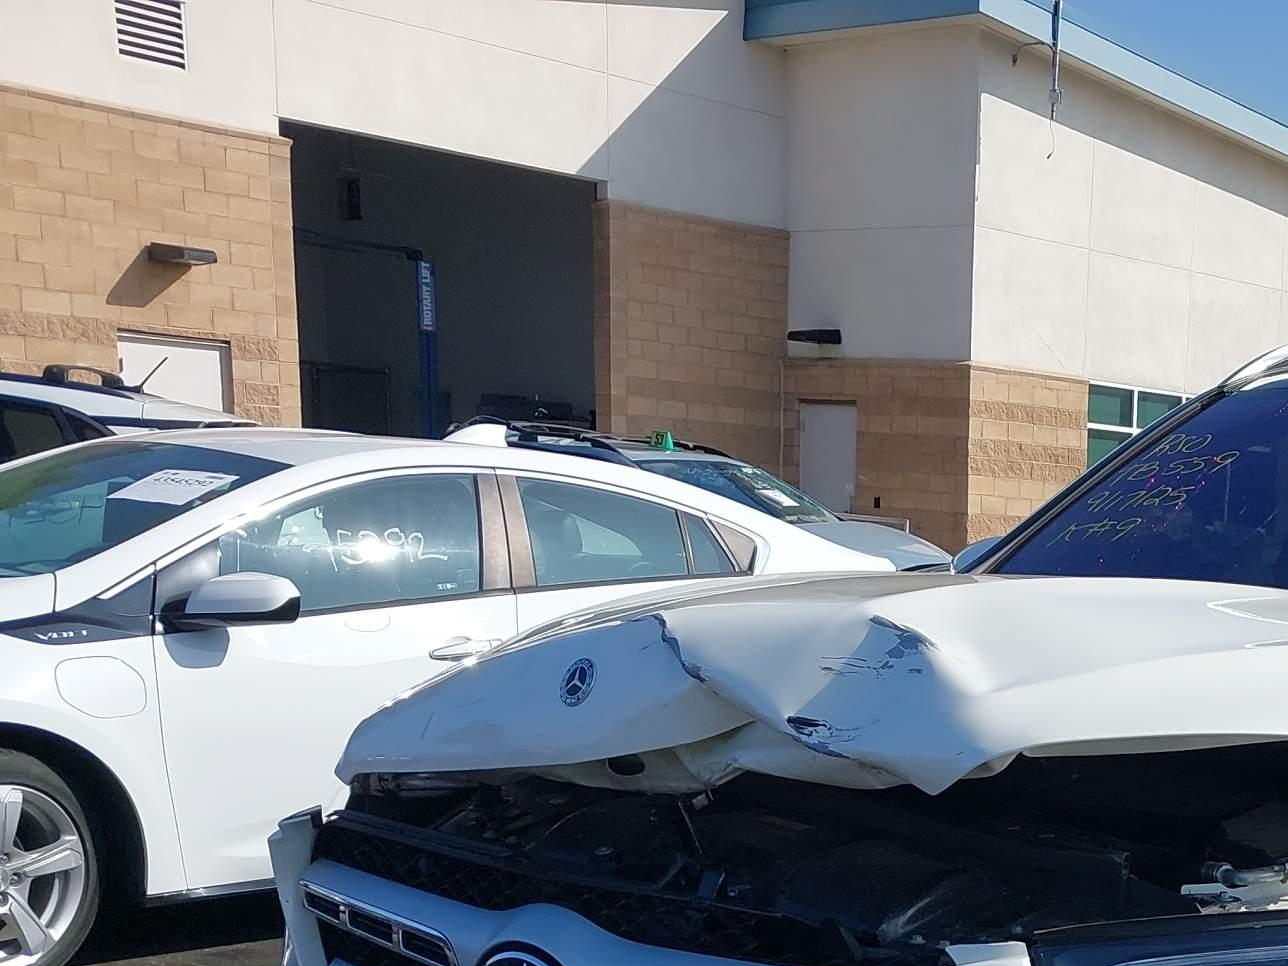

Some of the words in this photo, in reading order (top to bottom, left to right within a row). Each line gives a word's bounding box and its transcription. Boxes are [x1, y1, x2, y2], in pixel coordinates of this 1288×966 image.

[421, 262, 431, 282] LIFT
[423, 285, 433, 325] ROTARY
[34, 629, 89, 640] VOLT
